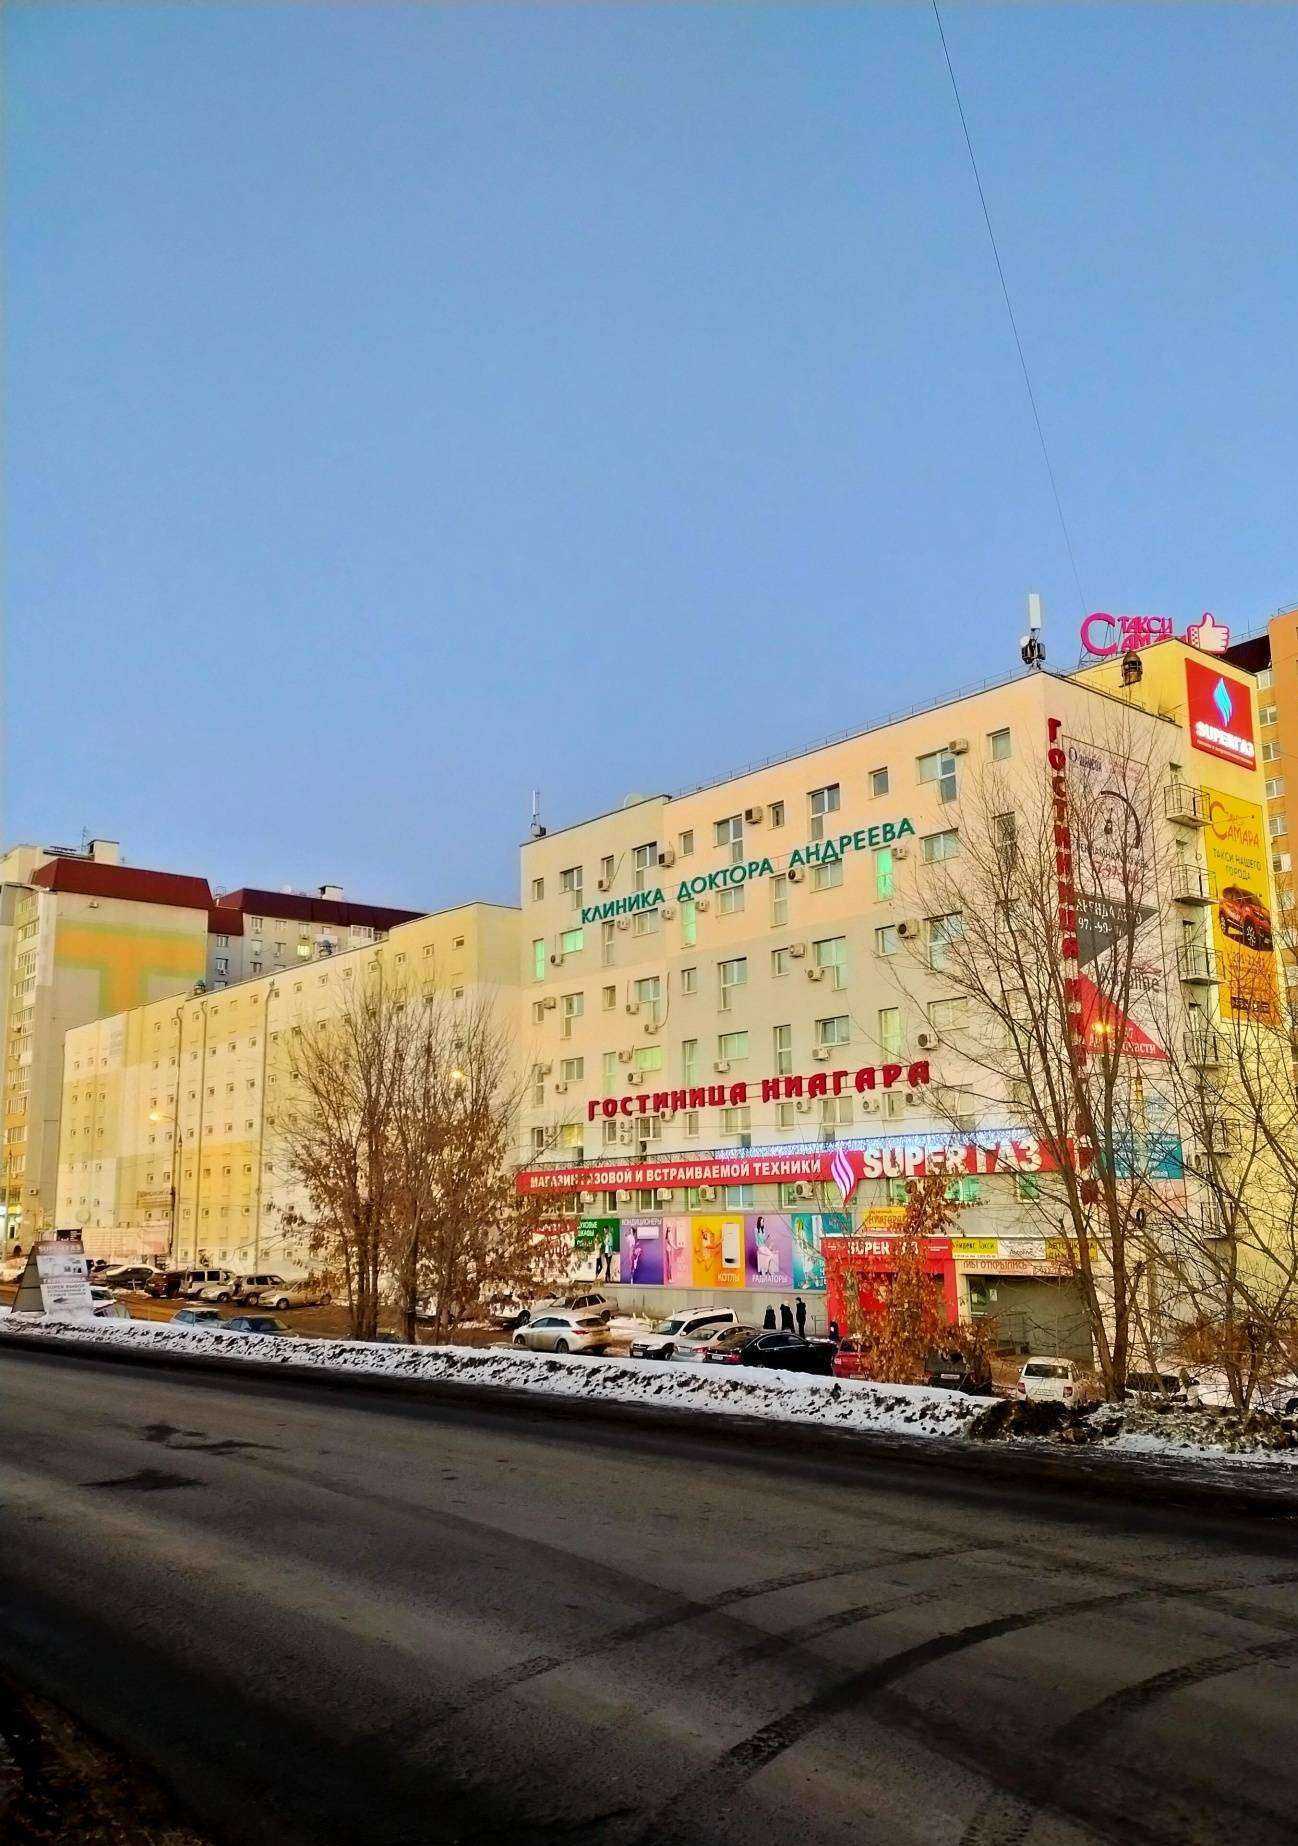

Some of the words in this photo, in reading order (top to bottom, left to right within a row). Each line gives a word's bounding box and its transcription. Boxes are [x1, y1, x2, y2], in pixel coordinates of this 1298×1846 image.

[1118, 615, 1173, 633] ТАКСИ
[581, 886, 665, 924] КЛИНИКА
[677, 856, 774, 902] ДОКТОРА
[788, 817, 916, 868] АНДРЕЕВА
[587, 1081, 747, 1121] ГОСТИНИЦА
[761, 1060, 931, 1103] НИАГАРА
[635, 1170, 643, 1183] И
[646, 1160, 750, 1182] ВСТРАИВАЕМОЙ
[753, 1158, 821, 1176] ТЕХНИКИ
[718, 1271, 740, 1282] КОТЛЫ
[752, 1273, 788, 1284] РАДИАТОРЫ
